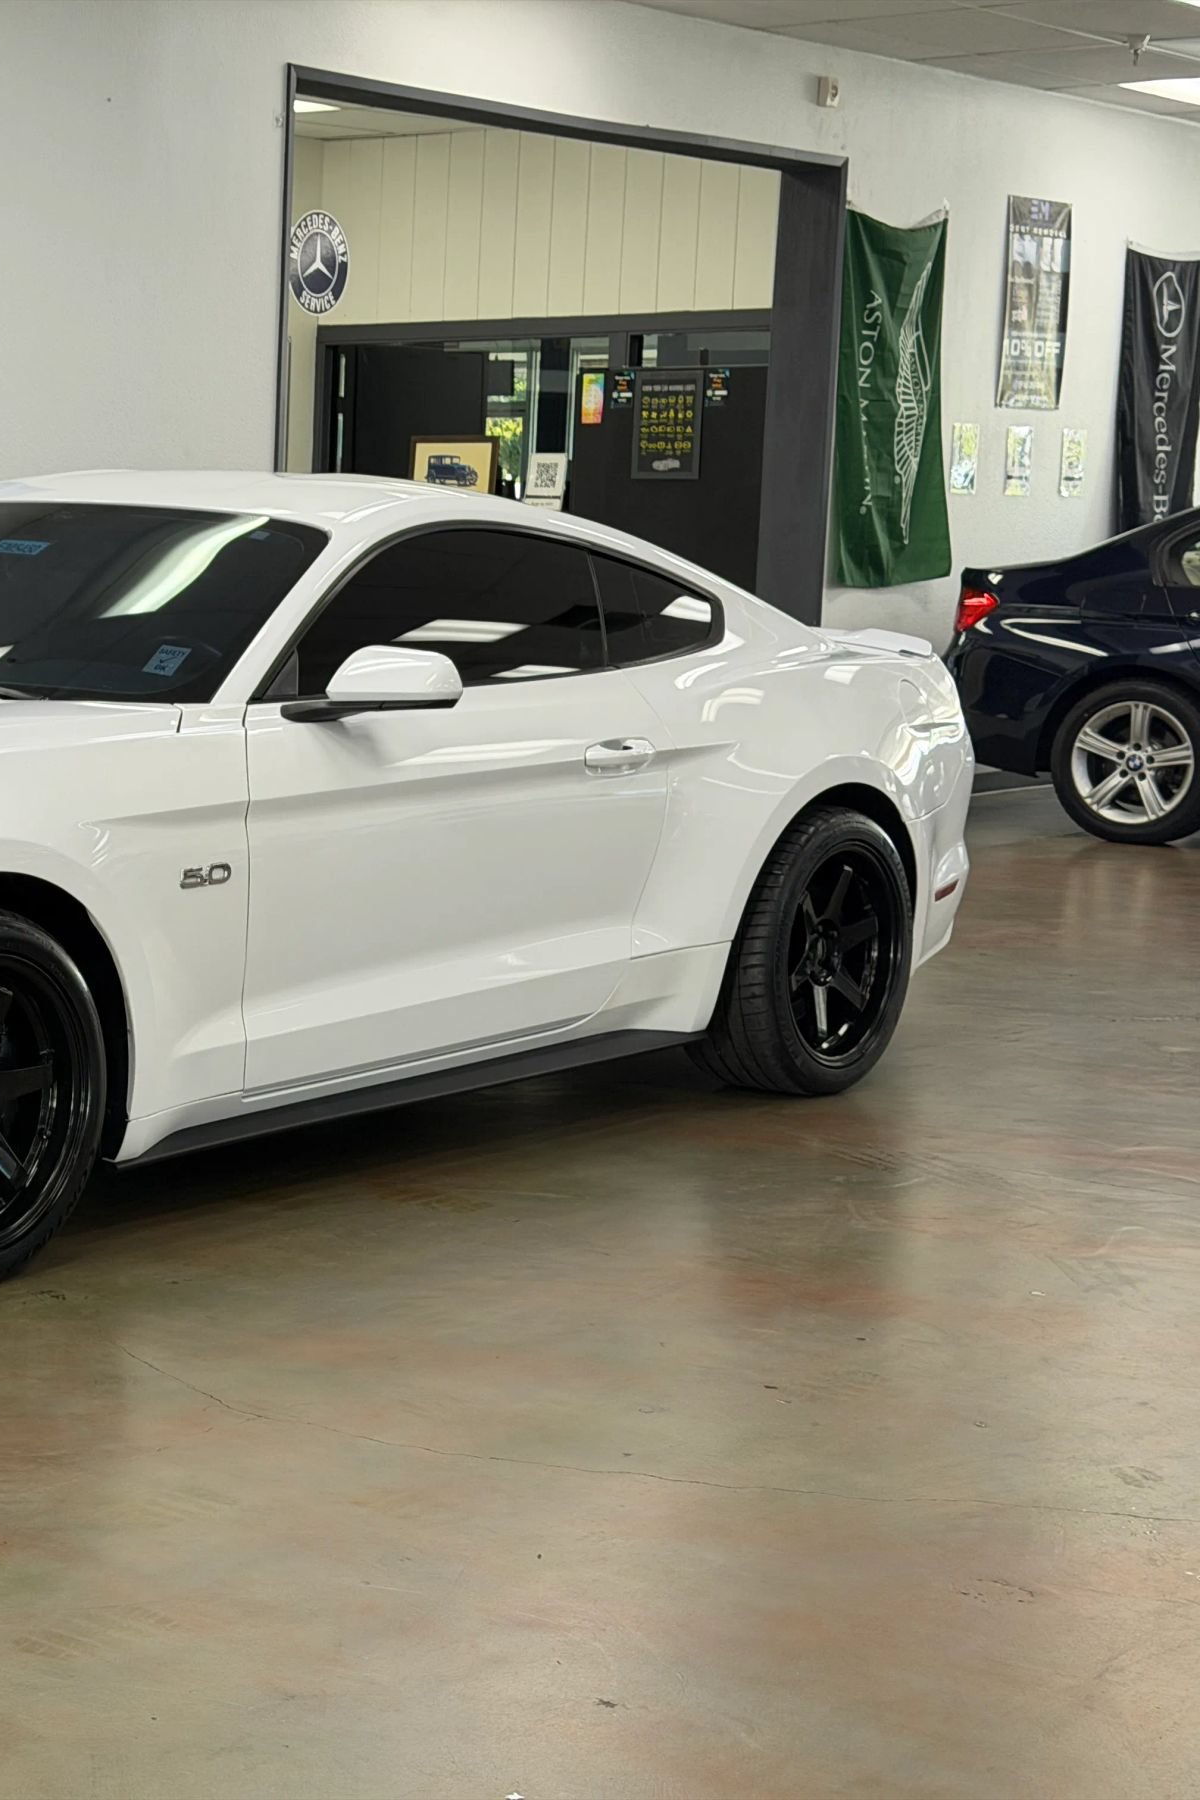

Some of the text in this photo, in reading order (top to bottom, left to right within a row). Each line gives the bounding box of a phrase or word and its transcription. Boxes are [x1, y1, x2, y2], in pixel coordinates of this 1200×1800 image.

[300, 290, 337, 313] SERVICE
[858, 290, 882, 388] ASTON
[180, 863, 231, 889] 5.0
